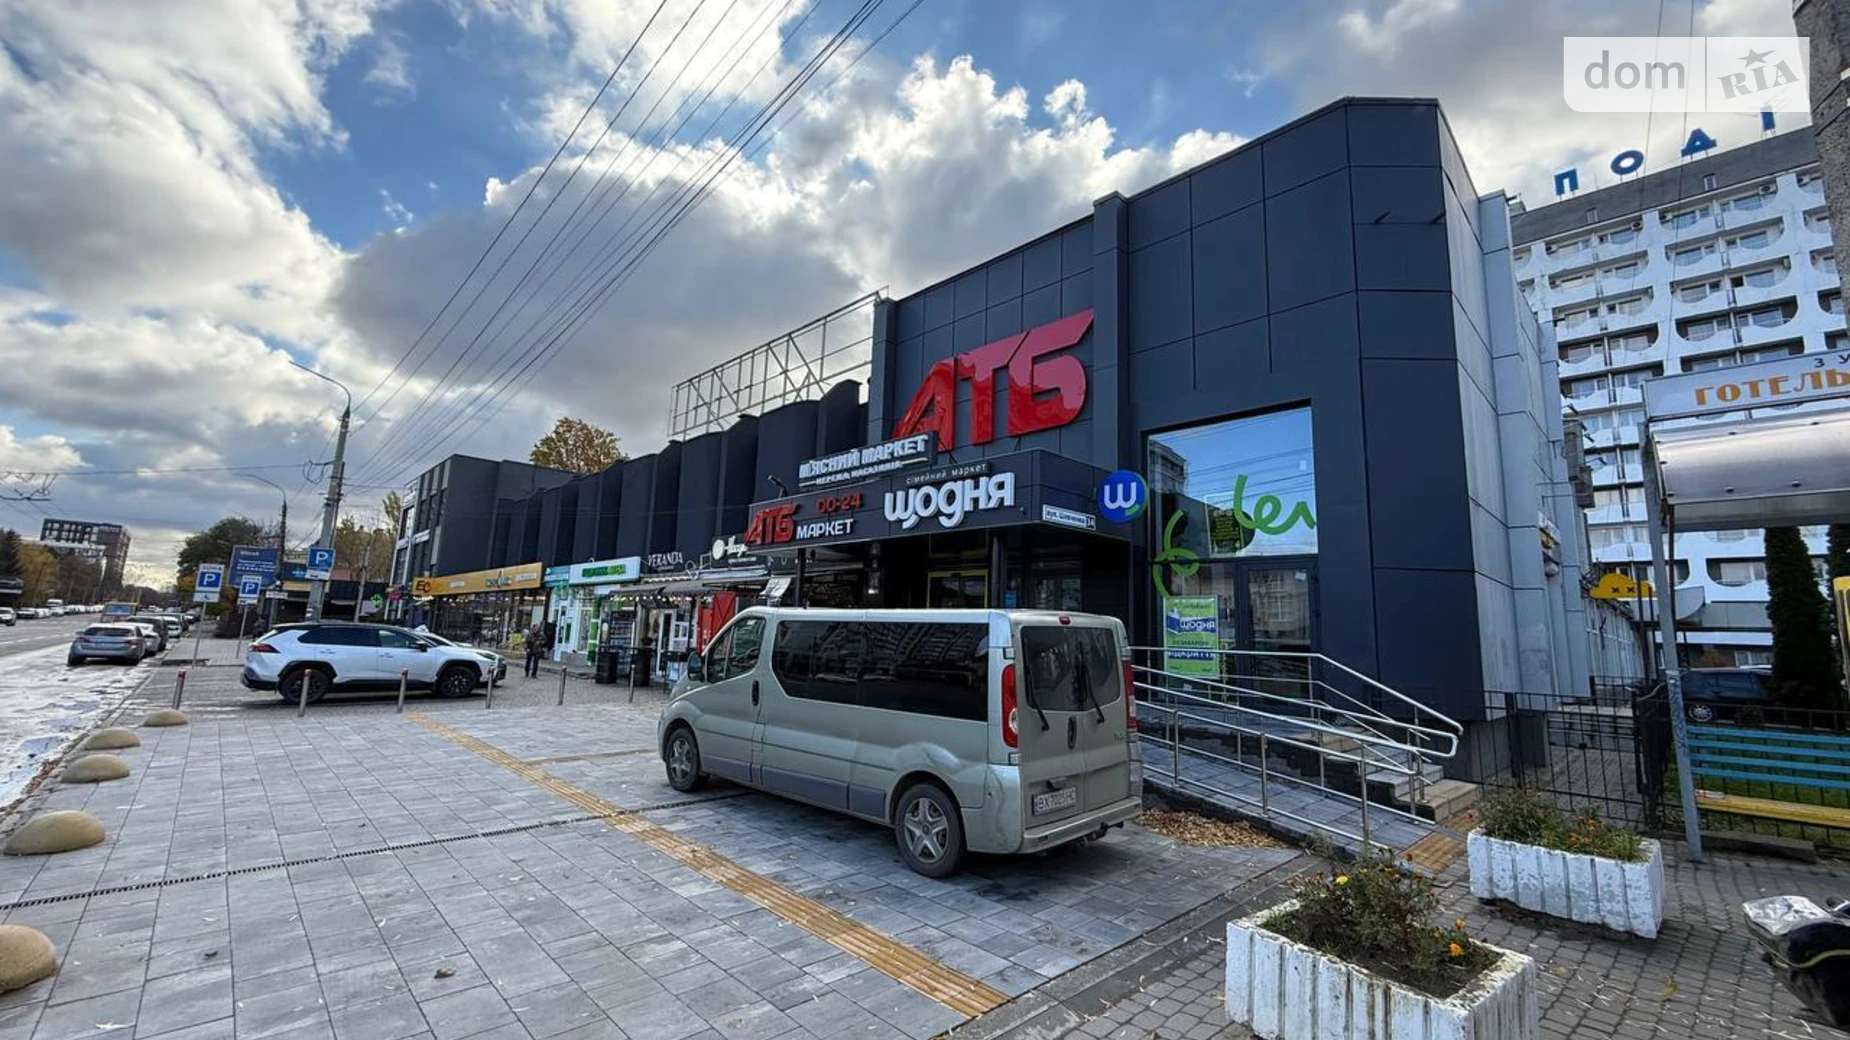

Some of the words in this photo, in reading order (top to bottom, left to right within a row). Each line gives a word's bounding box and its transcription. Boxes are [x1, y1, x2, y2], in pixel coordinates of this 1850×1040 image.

[892, 307, 1094, 452] АТБ
[861, 435, 928, 464] МАРКЕТ
[951, 463, 987, 476] маркет
[815, 492, 862, 513] 00-24
[743, 503, 798, 545] АТБ
[795, 518, 854, 540] МАРКЕТ
[315, 551, 329, 564] P
[203, 573, 216, 586] P
[245, 583, 256, 593] P
